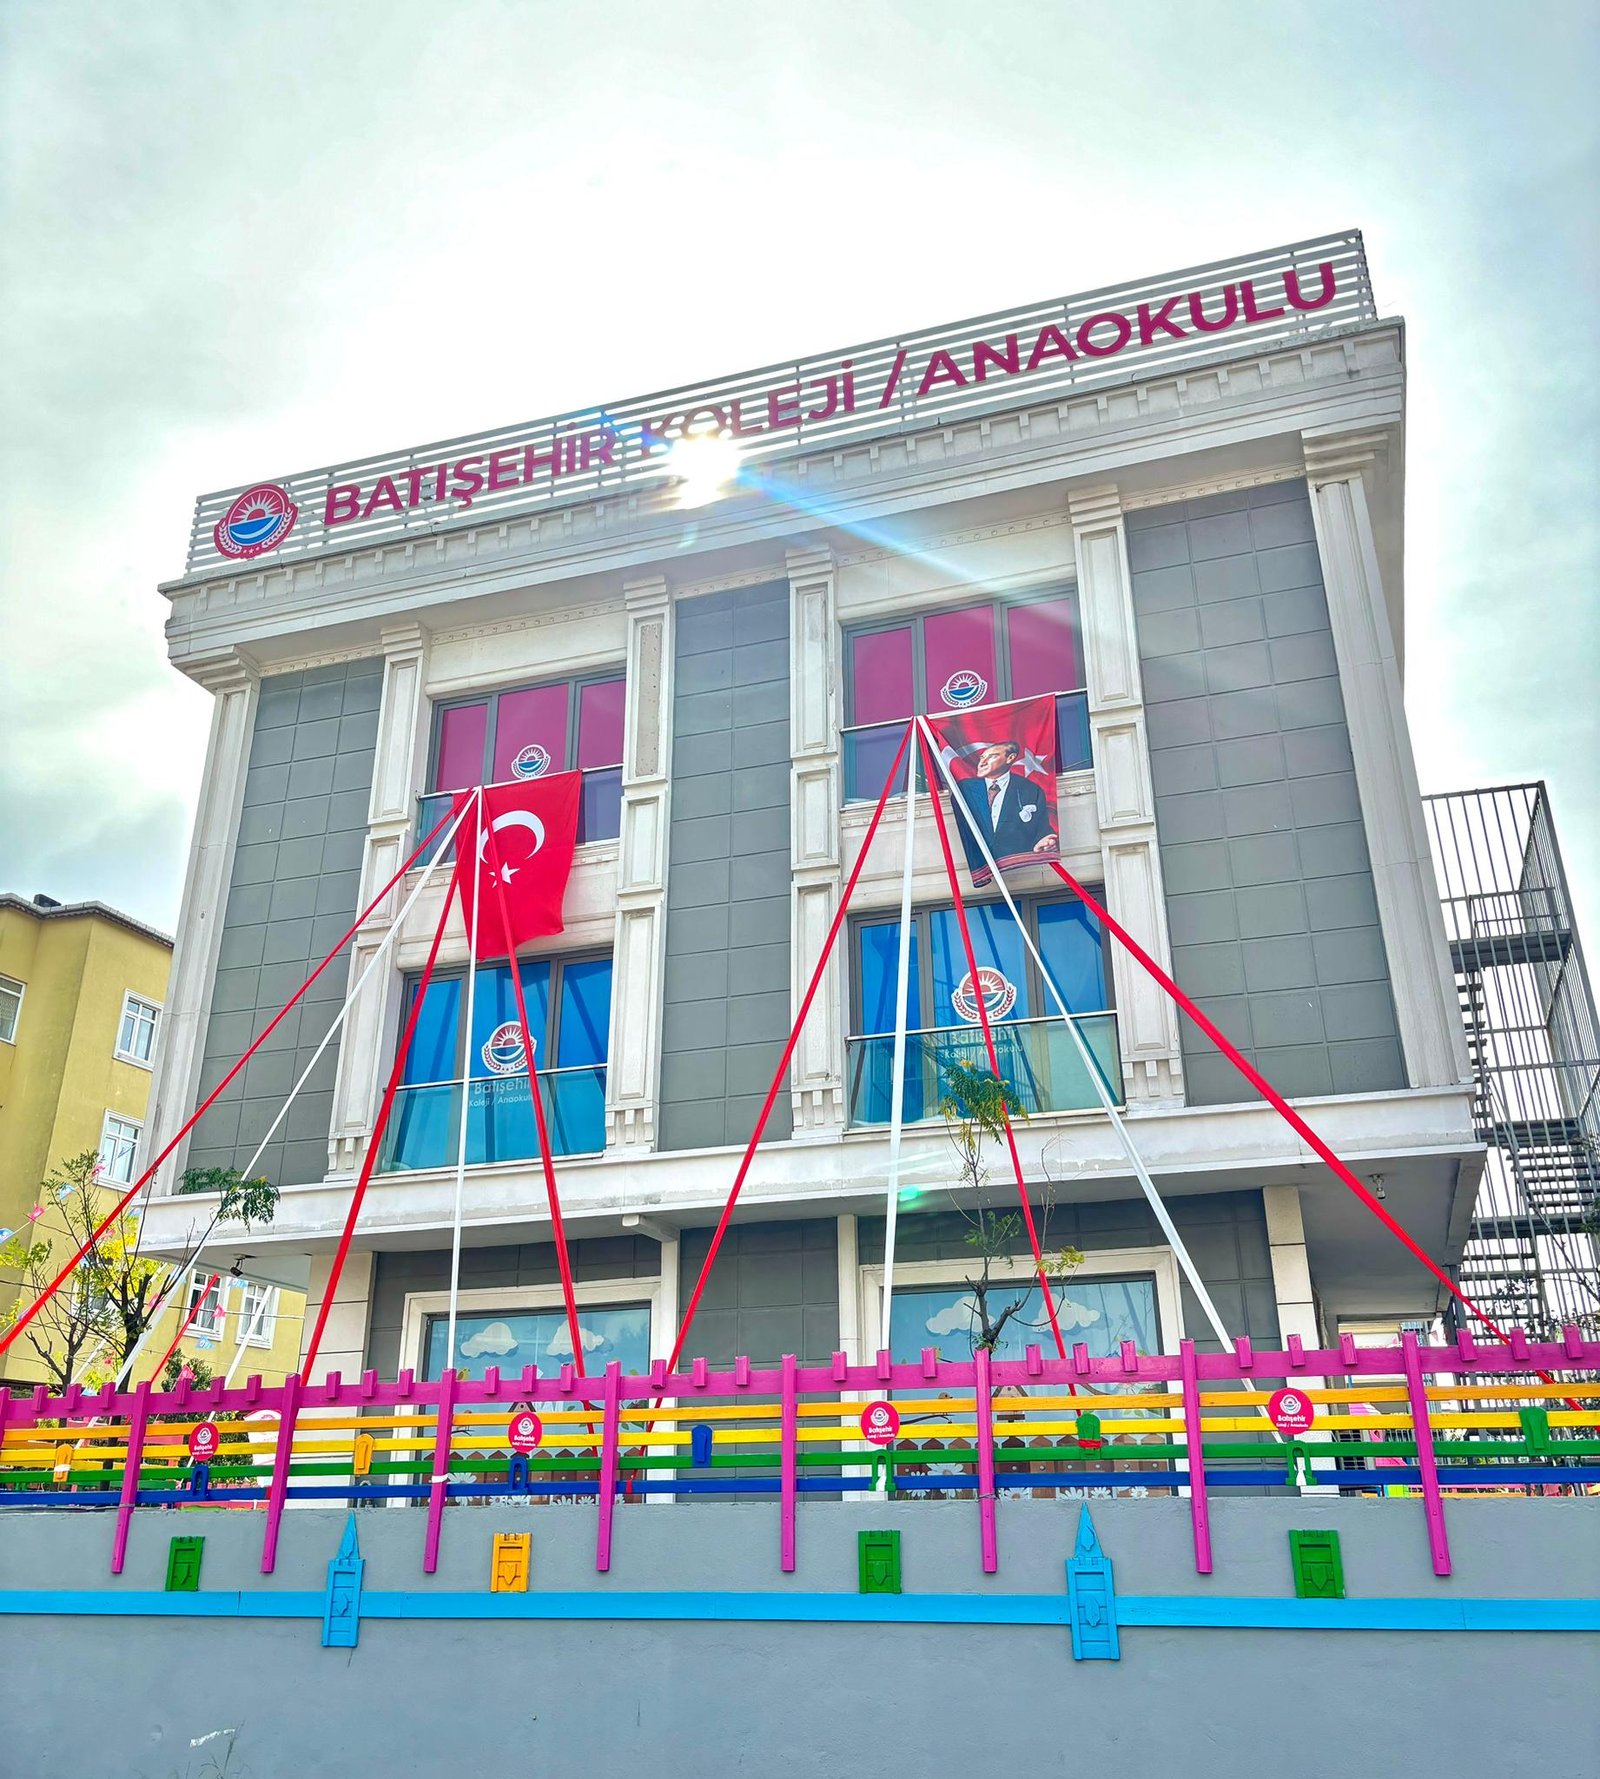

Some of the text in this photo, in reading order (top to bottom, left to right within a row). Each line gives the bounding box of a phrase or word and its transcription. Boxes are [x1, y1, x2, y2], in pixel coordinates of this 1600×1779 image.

[323, 262, 1337, 526] BATIŞEHİR KOLEJİ / ANAOKULU
[497, 1094, 531, 1105] Anaokul
